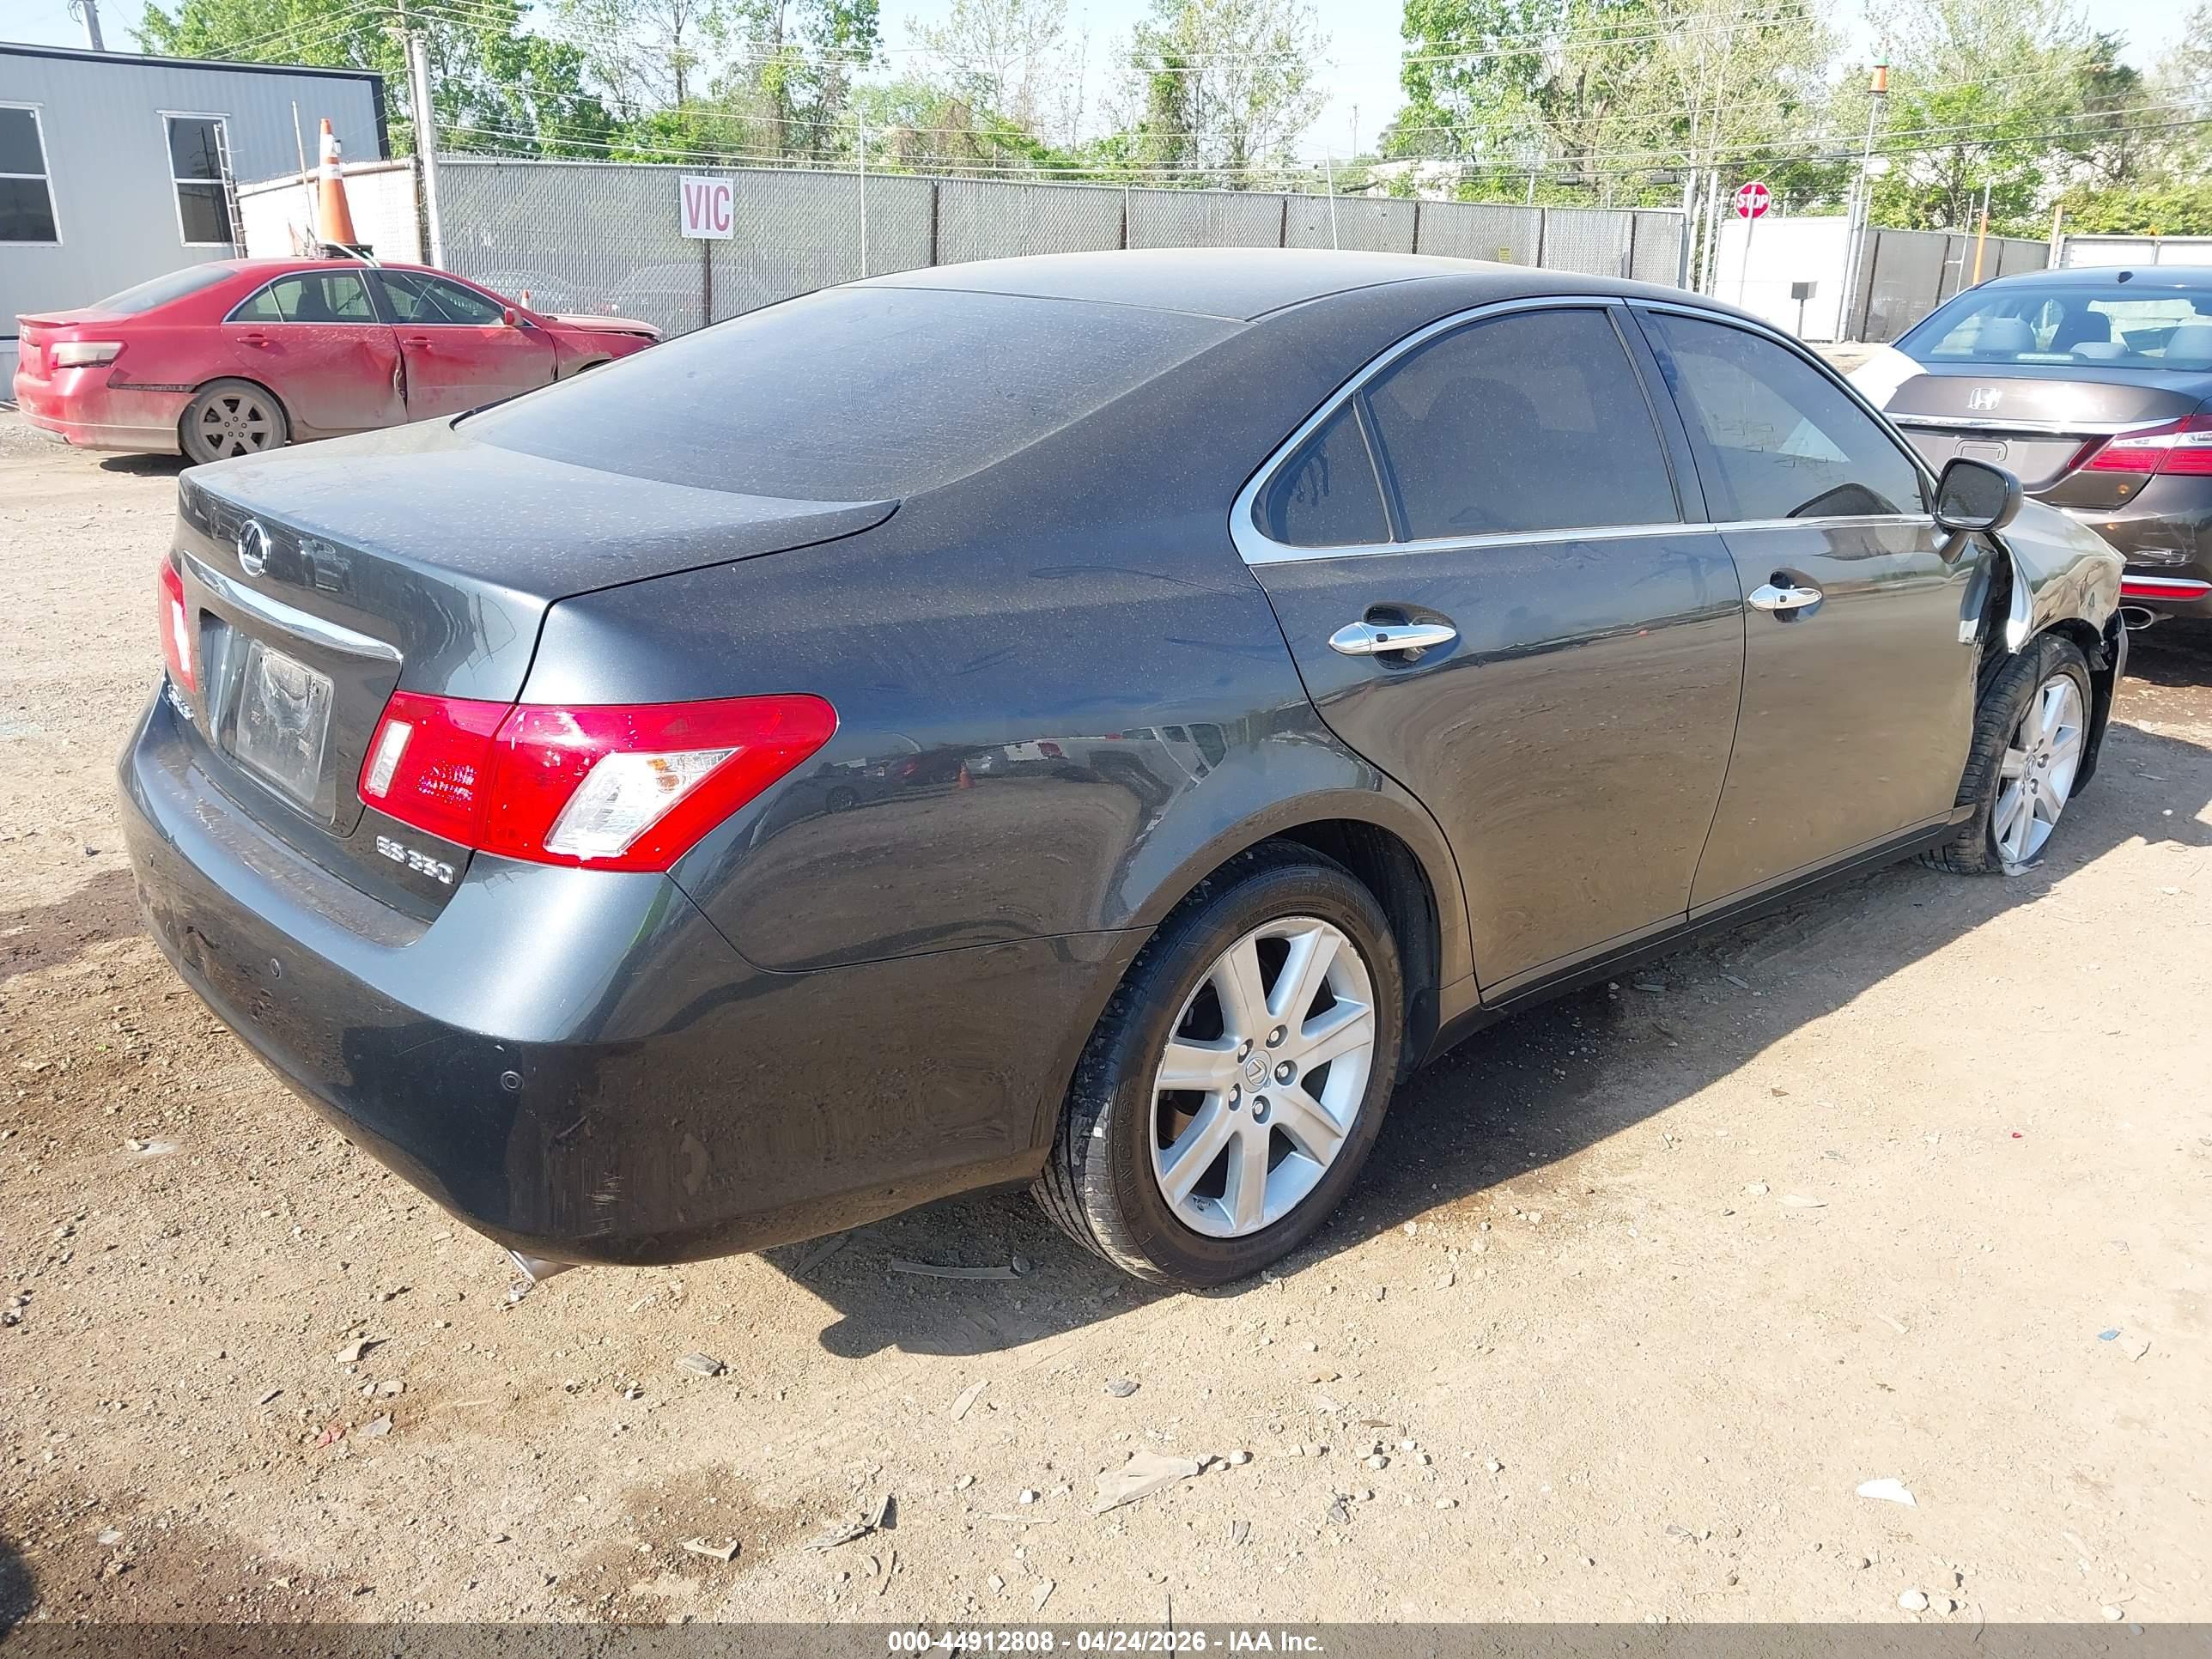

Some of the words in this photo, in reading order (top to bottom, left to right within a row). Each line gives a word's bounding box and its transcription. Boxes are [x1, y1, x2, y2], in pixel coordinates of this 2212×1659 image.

[684, 184, 730, 232] VIC
[1736, 193, 1769, 209] STOP
[376, 835, 407, 864] ES
